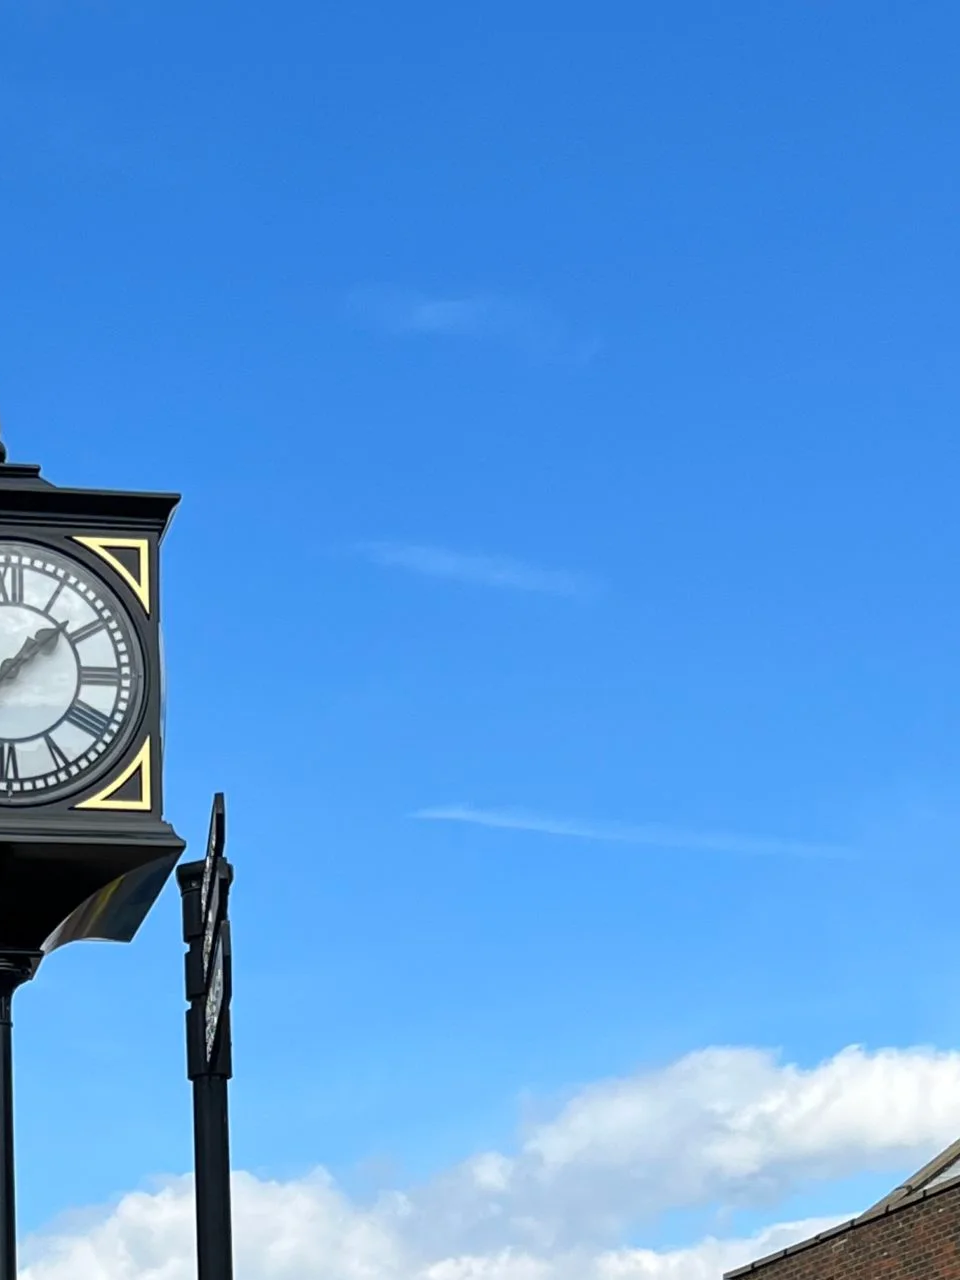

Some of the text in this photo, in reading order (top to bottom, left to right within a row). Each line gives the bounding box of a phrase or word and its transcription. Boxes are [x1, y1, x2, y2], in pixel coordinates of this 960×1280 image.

[68, 618, 108, 643] II
[80, 666, 120, 687] III
[0, 742, 19, 780] VI
